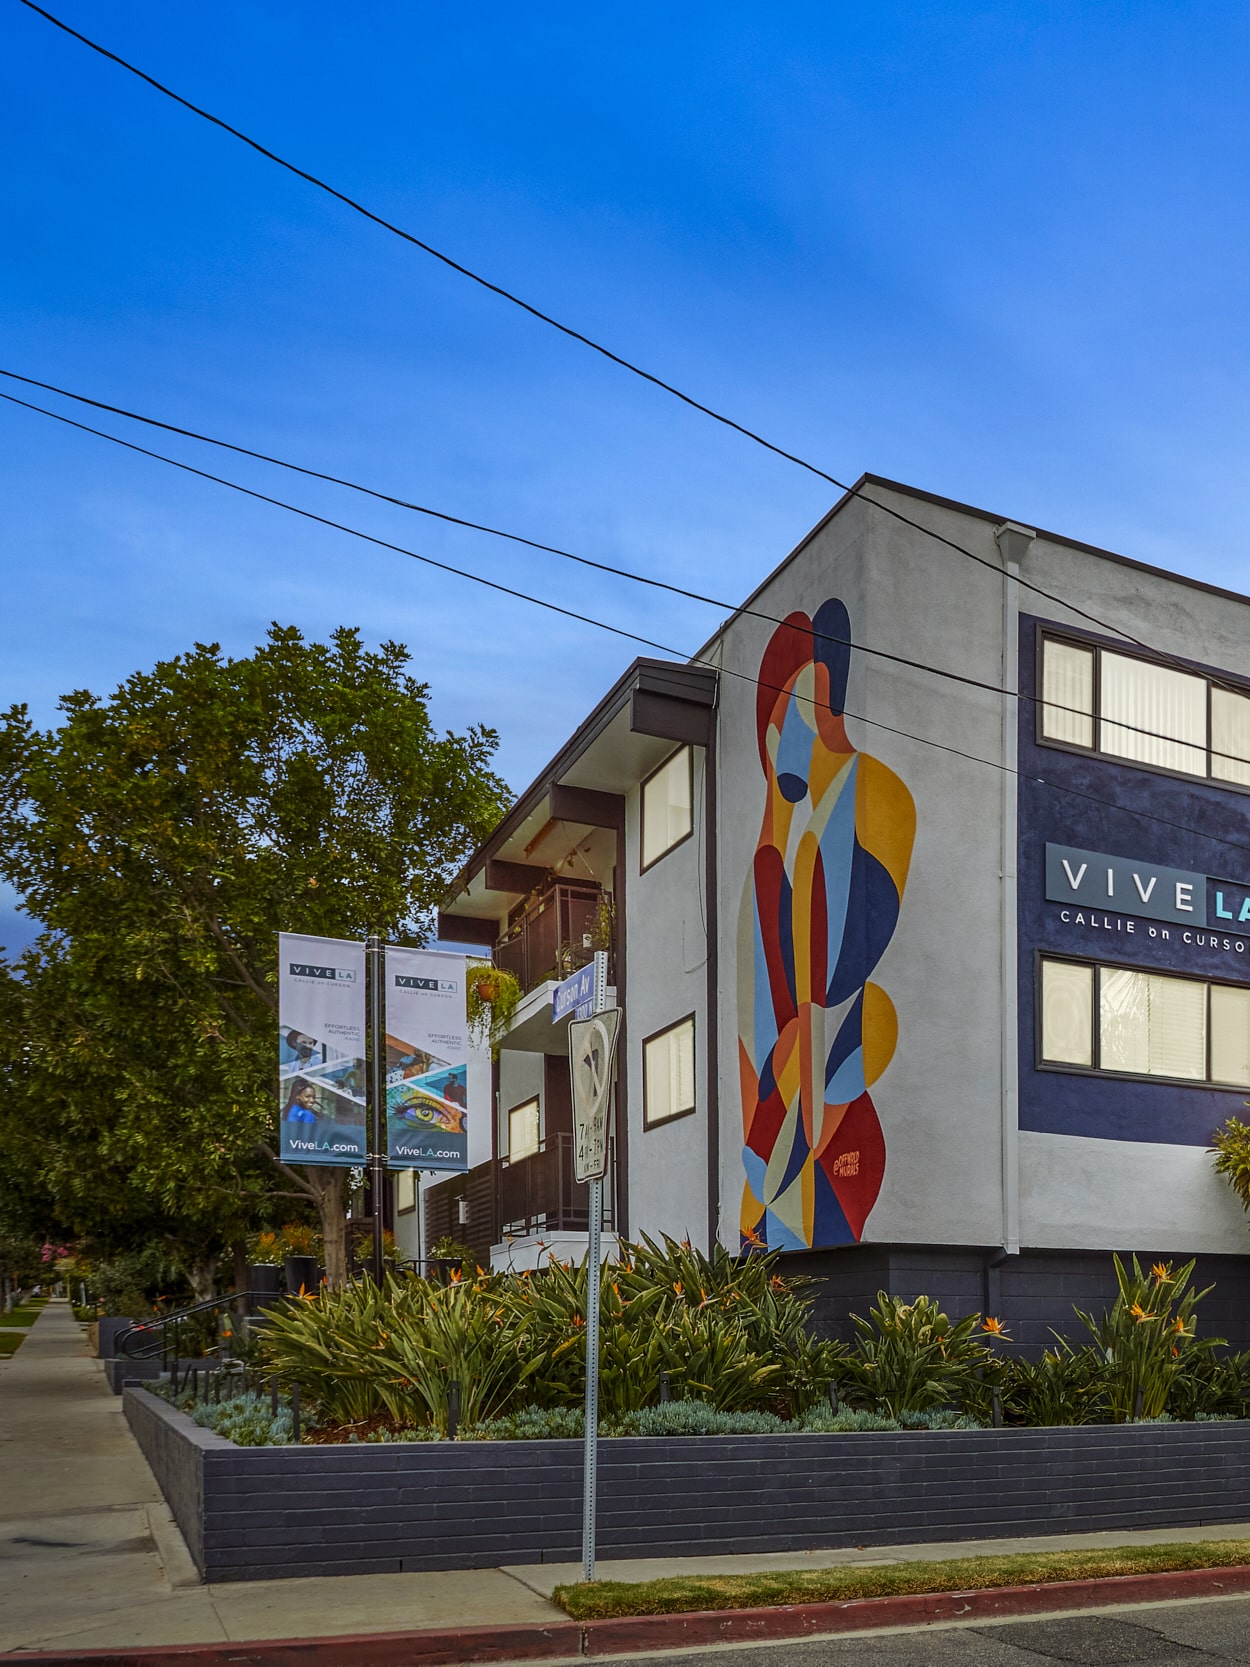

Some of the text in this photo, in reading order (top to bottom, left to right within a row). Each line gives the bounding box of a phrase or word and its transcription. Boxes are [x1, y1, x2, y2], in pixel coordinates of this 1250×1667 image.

[1061, 859, 1194, 912] VIVE
[1060, 910, 1136, 933] CALLIE
[293, 966, 353, 979] VIVE LA
[398, 977, 435, 989] VIVE
[556, 974, 590, 1012] Curson Av
[289, 1139, 358, 1153] ViveLA.com
[396, 1145, 460, 1159] ViveLA.com
